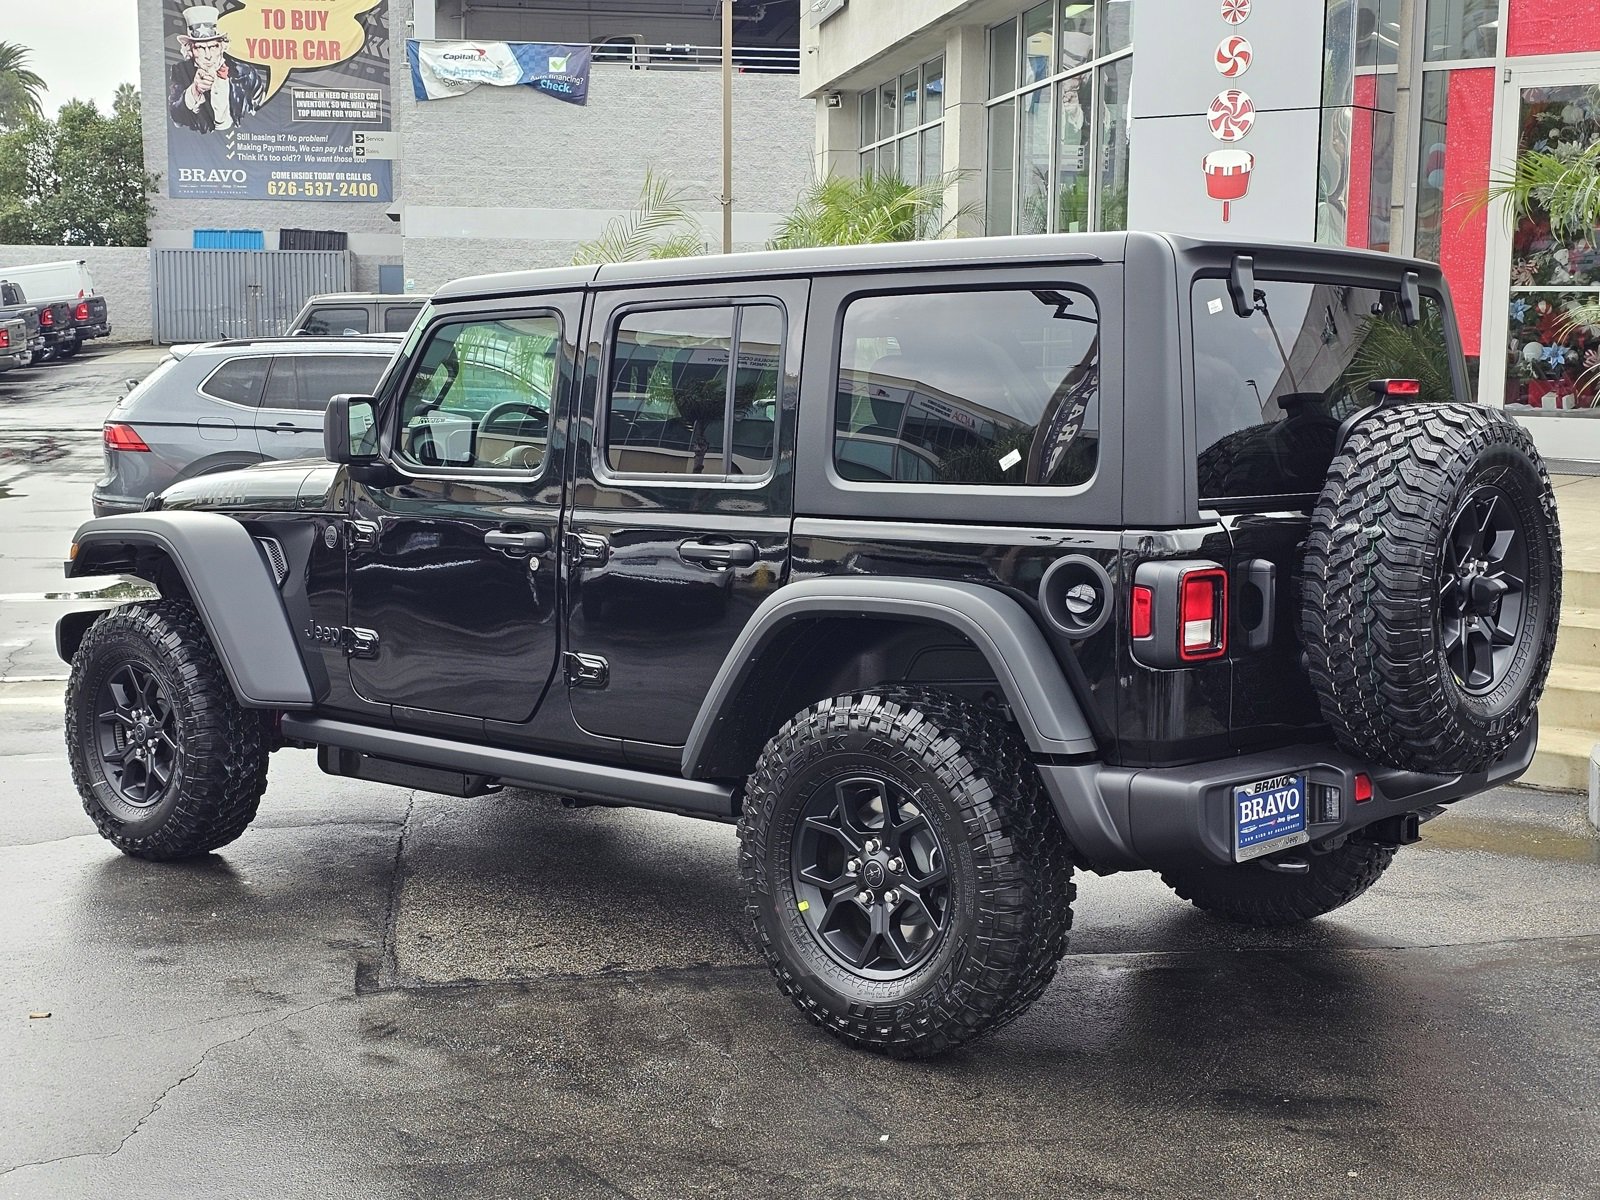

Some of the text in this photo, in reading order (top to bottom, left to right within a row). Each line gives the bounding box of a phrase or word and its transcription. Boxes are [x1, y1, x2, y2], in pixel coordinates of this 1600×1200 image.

[261, 9, 329, 31] TO BUY
[246, 38, 341, 60] YOUR CAR
[540, 79, 572, 93] Check.
[294, 91, 304, 99] WE
[305, 91, 317, 99] ARE
[341, 92, 349, 100] OF
[350, 92, 365, 100] USED
[366, 92, 379, 100] CAR
[296, 100, 330, 108] INVENTORY,
[341, 101, 350, 109] WE
[350, 101, 365, 109] WILL
[298, 109, 309, 117] TOP
[310, 109, 331, 117] MONEY
[344, 110, 360, 118] YOUR
[236, 133, 328, 143] Still leasing it? No problem!
[236, 143, 261, 152] Making
[262, 143, 298, 153] Payments,
[299, 144, 310, 152] We
[324, 146, 337, 154] pay
[237, 153, 257, 161] Think
[178, 168, 247, 183] BRAVO
[271, 171, 372, 181] COME INSIDE TODAY OR CALL US
[267, 181, 378, 197] 626-537-2400
[304, 619, 341, 647] Jeep
[1254, 775, 1290, 793] BRAVO
[1240, 788, 1299, 824] BRAVO
